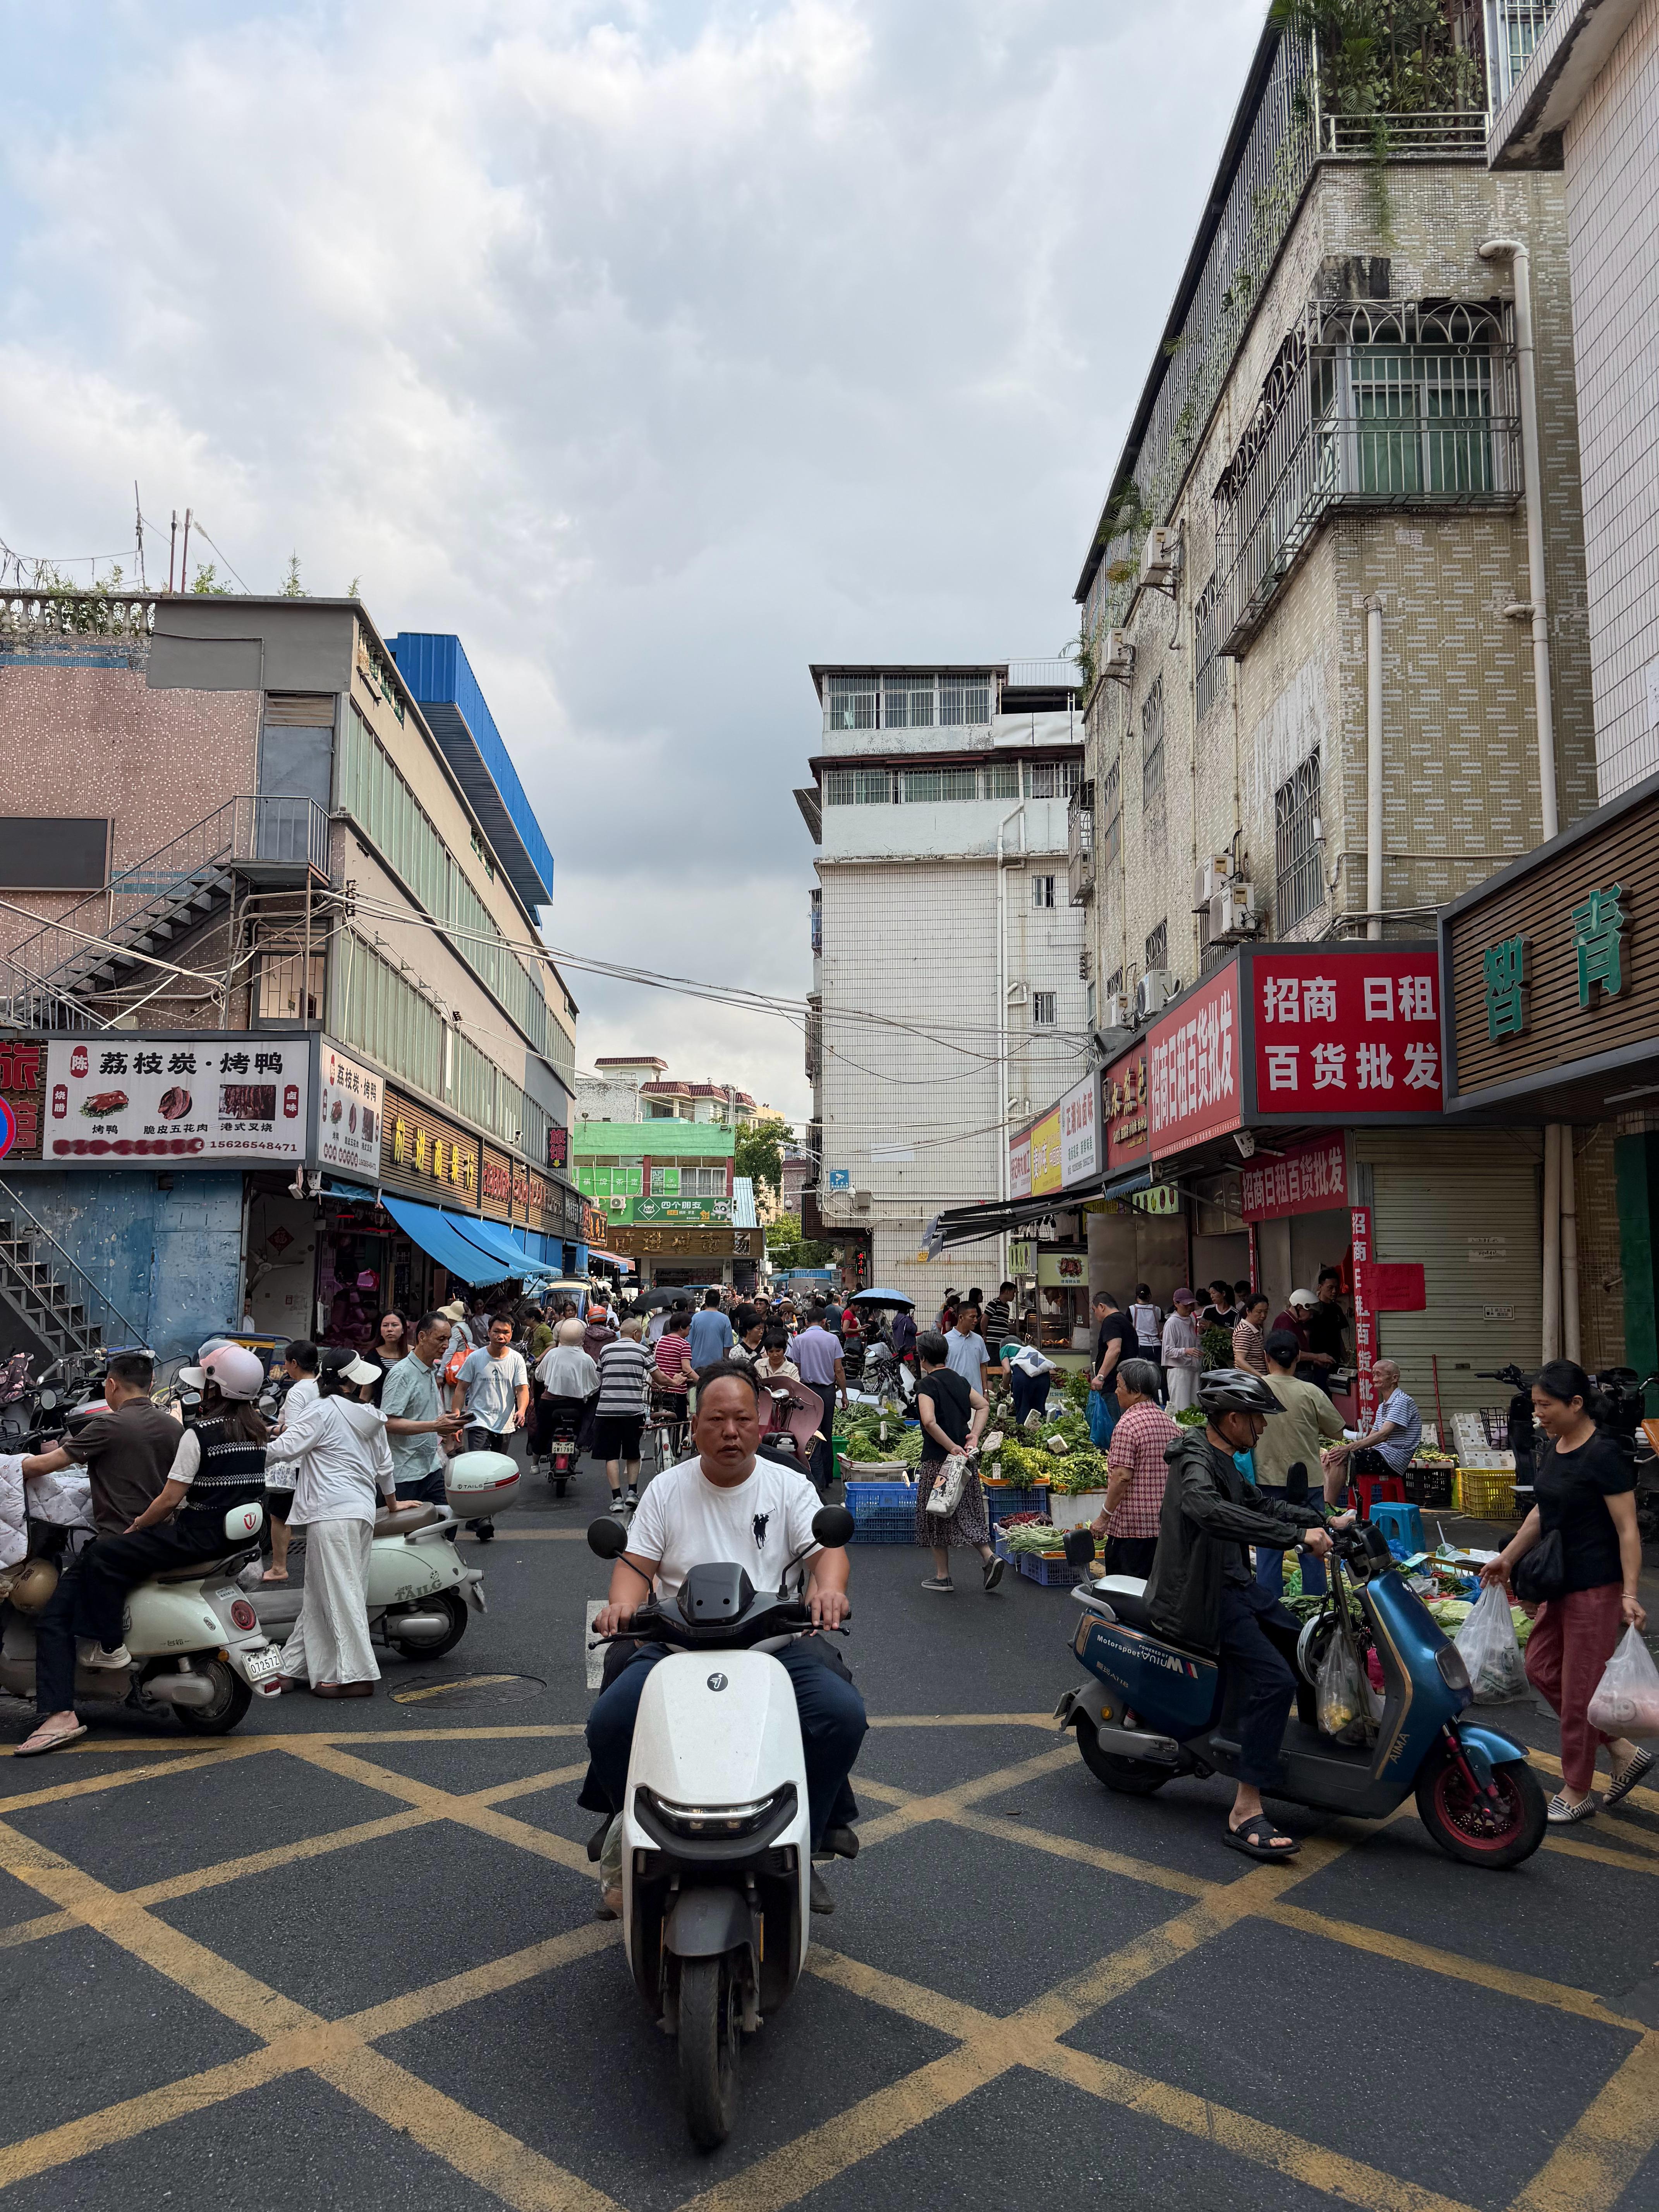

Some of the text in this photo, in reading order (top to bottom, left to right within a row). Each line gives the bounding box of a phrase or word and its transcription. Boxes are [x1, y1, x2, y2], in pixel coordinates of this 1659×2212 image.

[1264, 975, 1436, 1022] 招商 日租
[71, 1055, 88, 1071] 陈
[99, 1052, 283, 1074] 荔枝炭·烤鸭
[1152, 989, 1233, 1133] 招商日租百货批发
[1265, 1042, 1440, 1091] 百货批发
[54, 1091, 66, 1112] 烧腊
[285, 1091, 297, 1112] 卤味
[92, 1124, 118, 1134] 烤鸭
[144, 1124, 208, 1134] 脆皮五花肉
[220, 1123, 273, 1132] 港式叉烧
[210, 1140, 297, 1151] 15626548471
[550, 1129, 566, 1160] 旅馆
[1242, 1146, 1344, 1211] 招商日租百货批发
[395, 1579, 442, 1601] TAILG
[250, 1656, 280, 1674] 07257Z
[1389, 1733, 1410, 1764] AIMA
